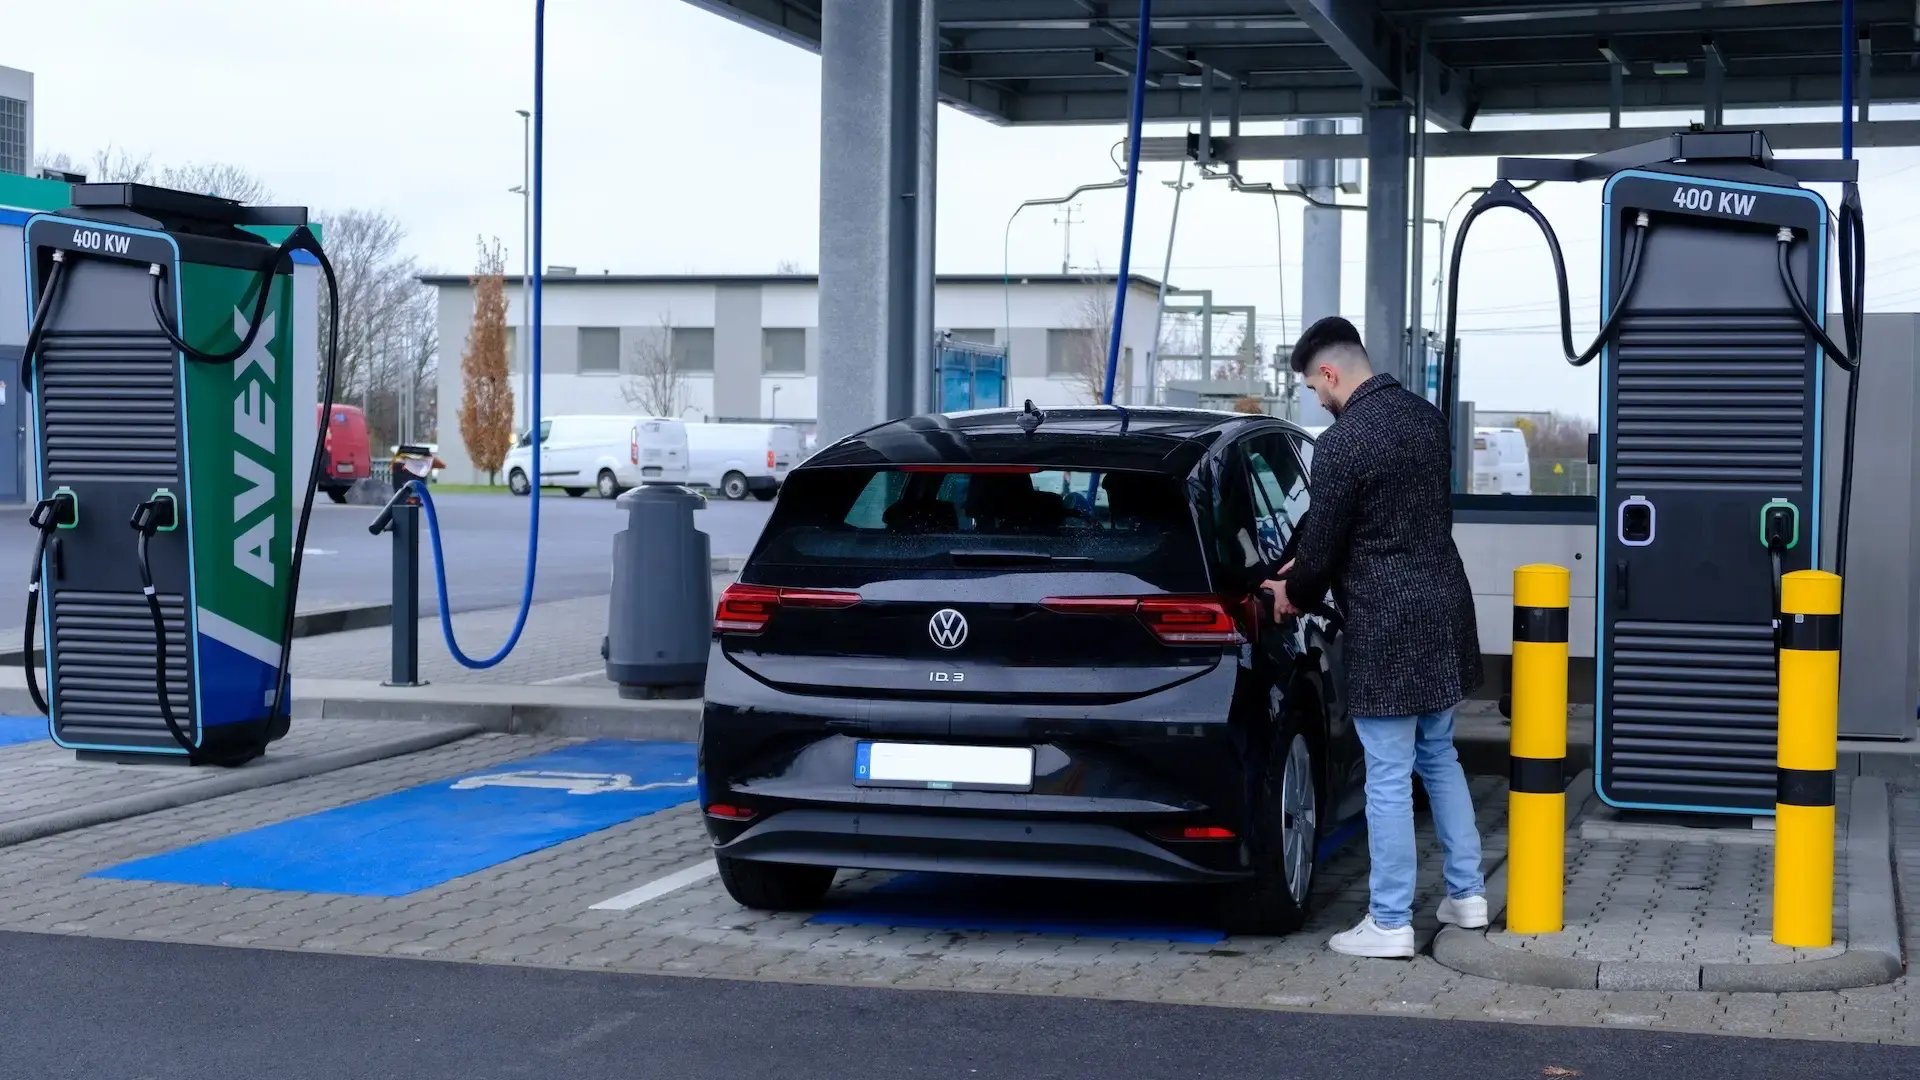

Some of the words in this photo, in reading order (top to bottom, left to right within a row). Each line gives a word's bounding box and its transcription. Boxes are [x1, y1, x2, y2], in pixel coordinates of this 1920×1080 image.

[1673, 187, 1713, 211] 400
[1718, 192, 1756, 215] KW
[73, 229, 101, 250] 400
[105, 234, 130, 254] KW
[234, 304, 275, 587] AVEX
[929, 608, 968, 649] VW
[859, 765, 866, 774] D
